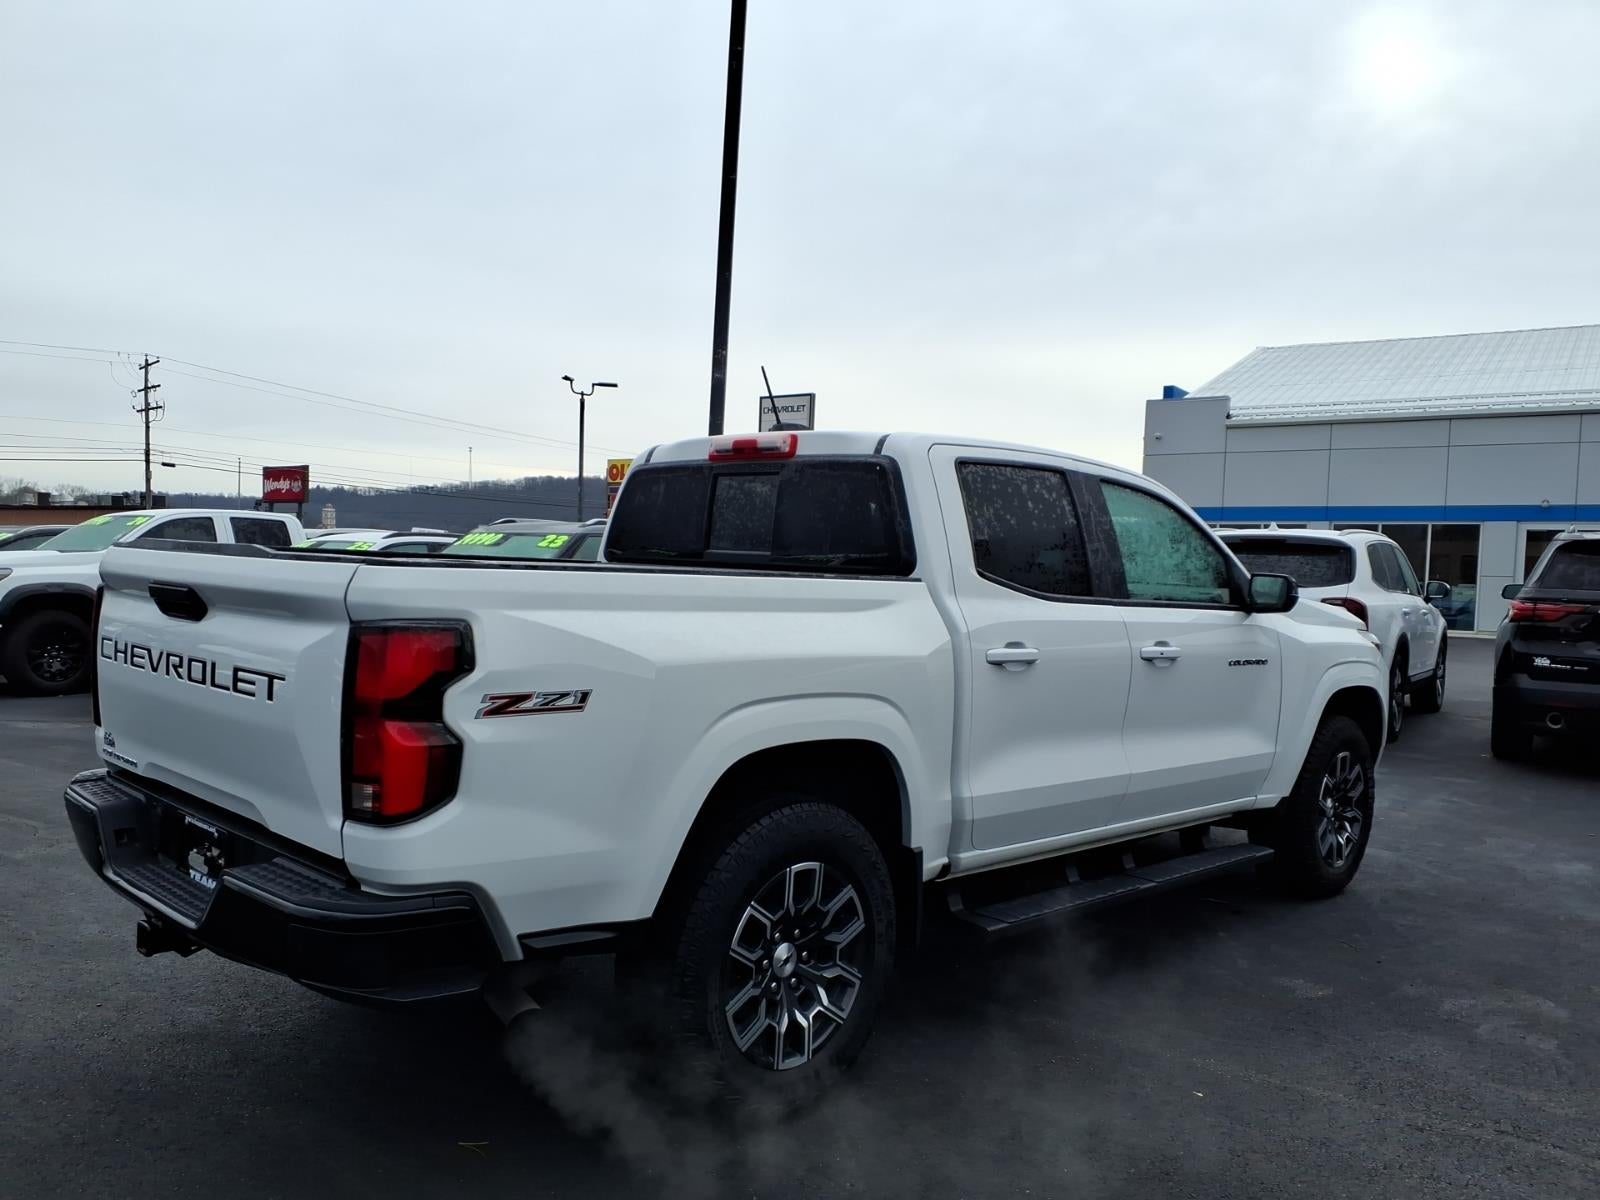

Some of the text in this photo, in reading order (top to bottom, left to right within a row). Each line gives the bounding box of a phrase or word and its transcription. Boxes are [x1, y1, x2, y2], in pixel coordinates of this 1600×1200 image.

[537, 535, 569, 548] 23
[100, 636, 287, 704] CHEVROLET
[1228, 659, 1269, 667] COLORADO
[474, 688, 594, 720] Z71
